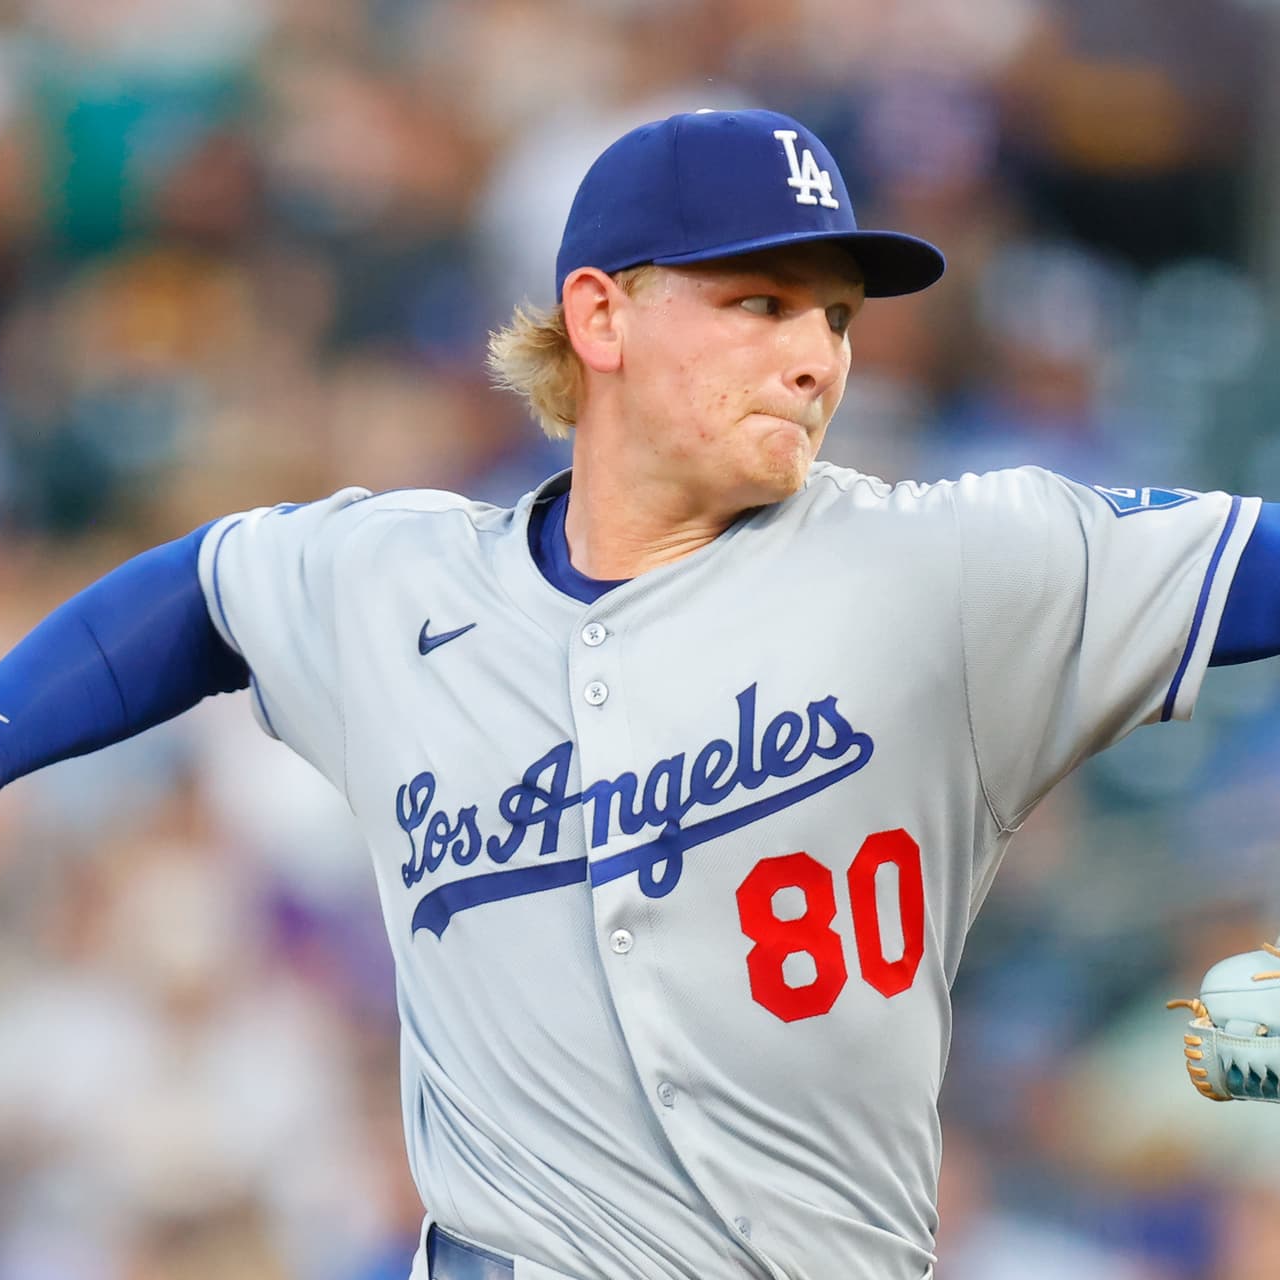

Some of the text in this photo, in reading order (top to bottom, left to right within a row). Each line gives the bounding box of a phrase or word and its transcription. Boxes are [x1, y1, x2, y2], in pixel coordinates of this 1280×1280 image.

[773, 130, 839, 209] LA
[395, 681, 862, 899] Los Angeles
[735, 827, 925, 1023] 80
